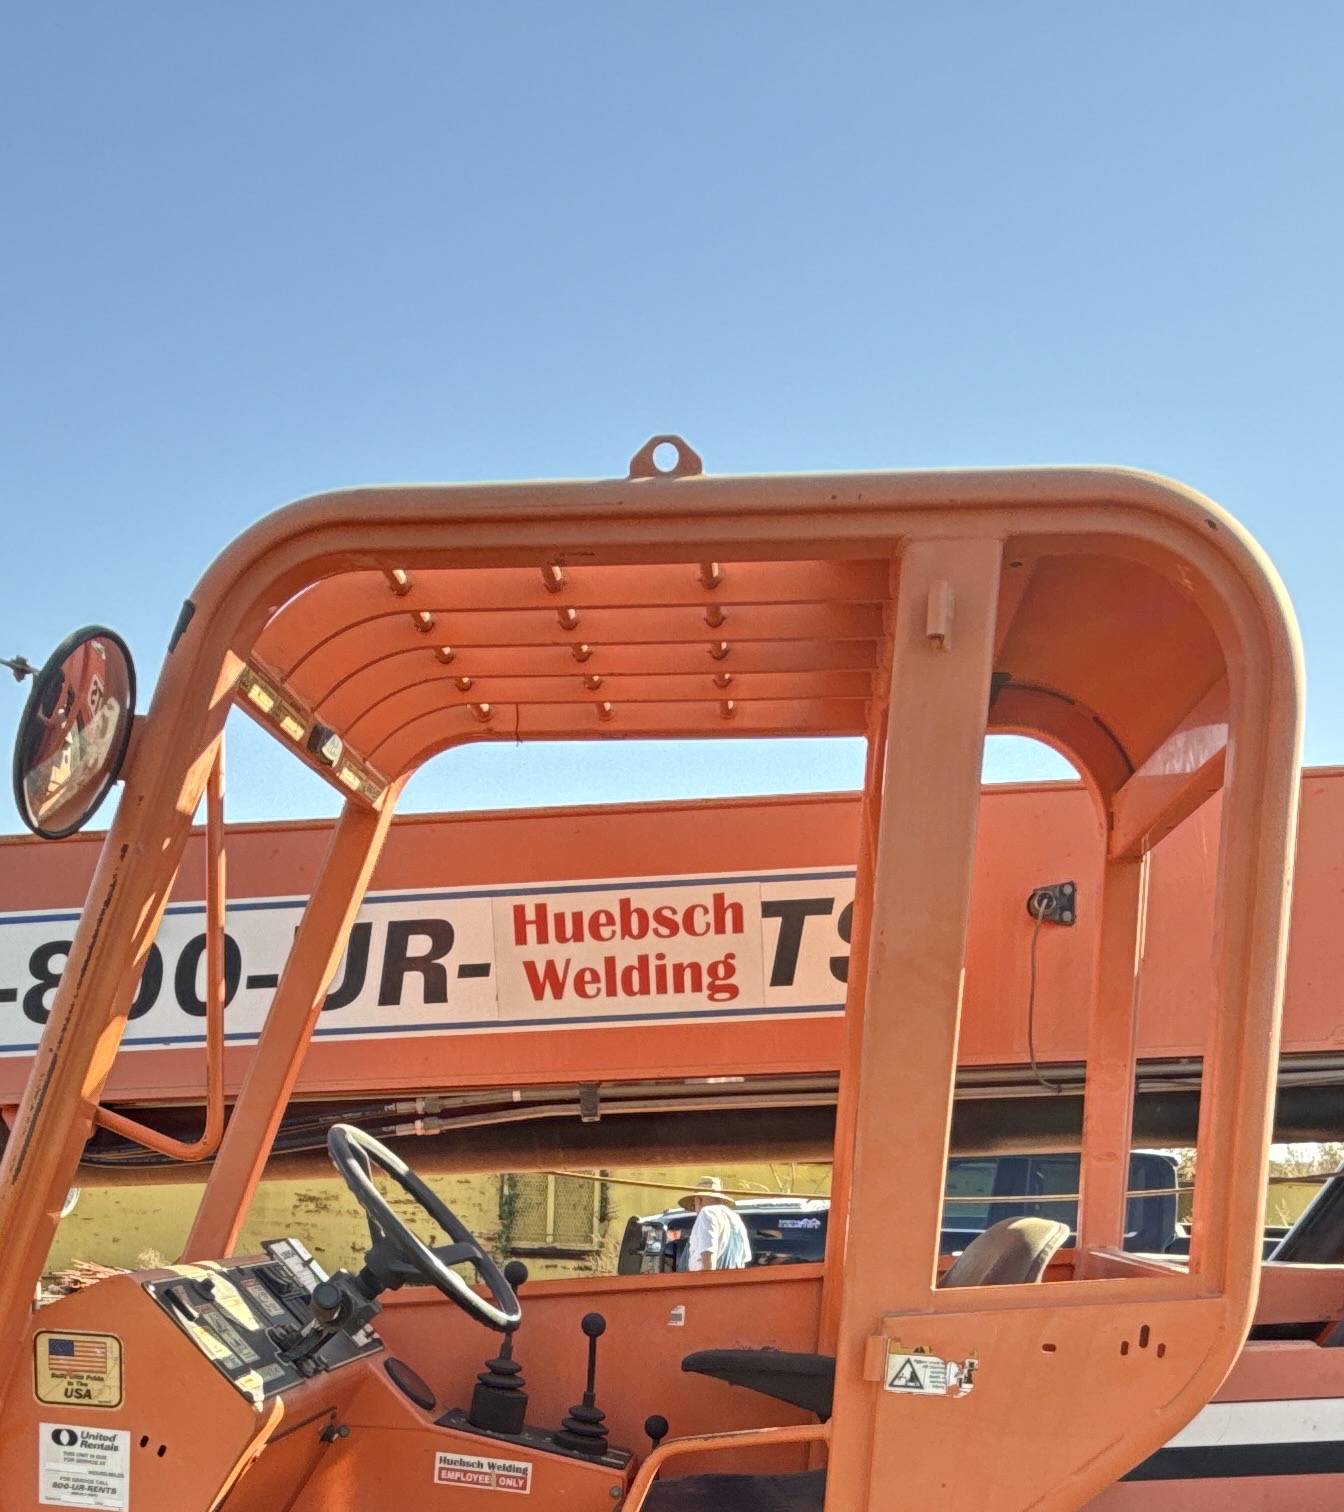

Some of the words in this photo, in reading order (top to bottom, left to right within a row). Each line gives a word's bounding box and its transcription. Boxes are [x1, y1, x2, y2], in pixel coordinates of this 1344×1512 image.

[513, 892, 744, 947] Huebsch
[523, 952, 739, 1002] Welding
[64, 1388, 92, 1399] USA
[80, 1431, 117, 1442] United
[80, 1440, 119, 1452] Rentals
[439, 1456, 484, 1470] Huebsch
[487, 1461, 529, 1476] Welding
[52, 1482, 117, 1494] 800-UR-RENTS
[498, 1476, 524, 1488] ONLY
